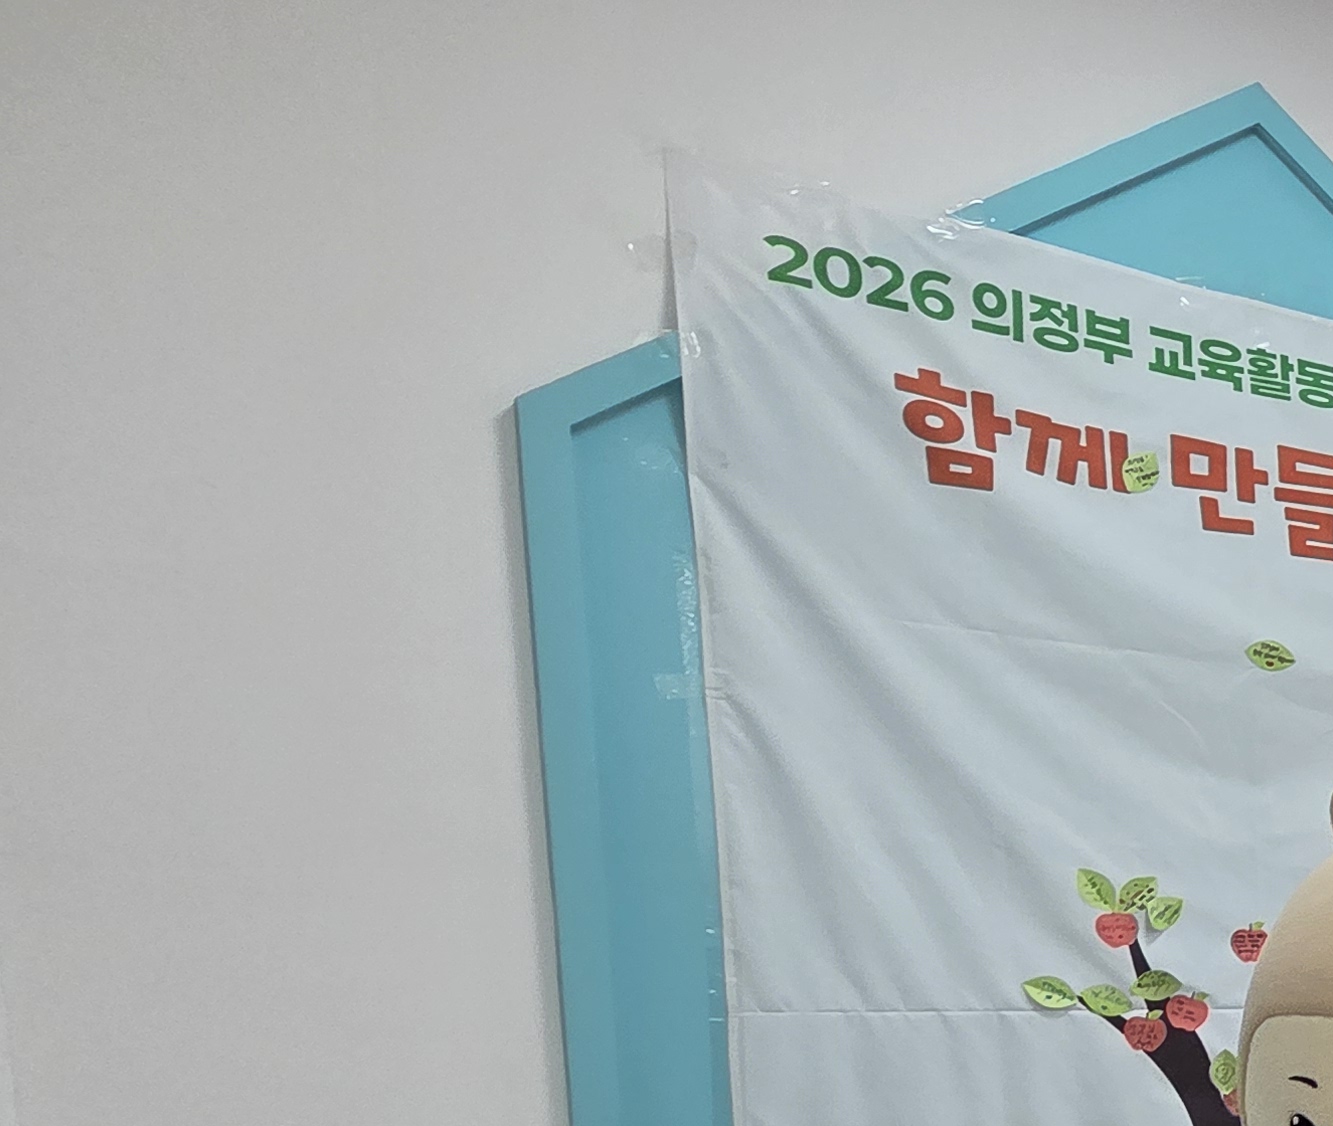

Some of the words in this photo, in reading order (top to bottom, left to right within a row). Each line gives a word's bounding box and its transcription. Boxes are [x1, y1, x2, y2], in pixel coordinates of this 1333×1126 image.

[763, 234, 955, 321] 2026
[971, 282, 1133, 365] 의정부
[894, 367, 1131, 494] 함께
